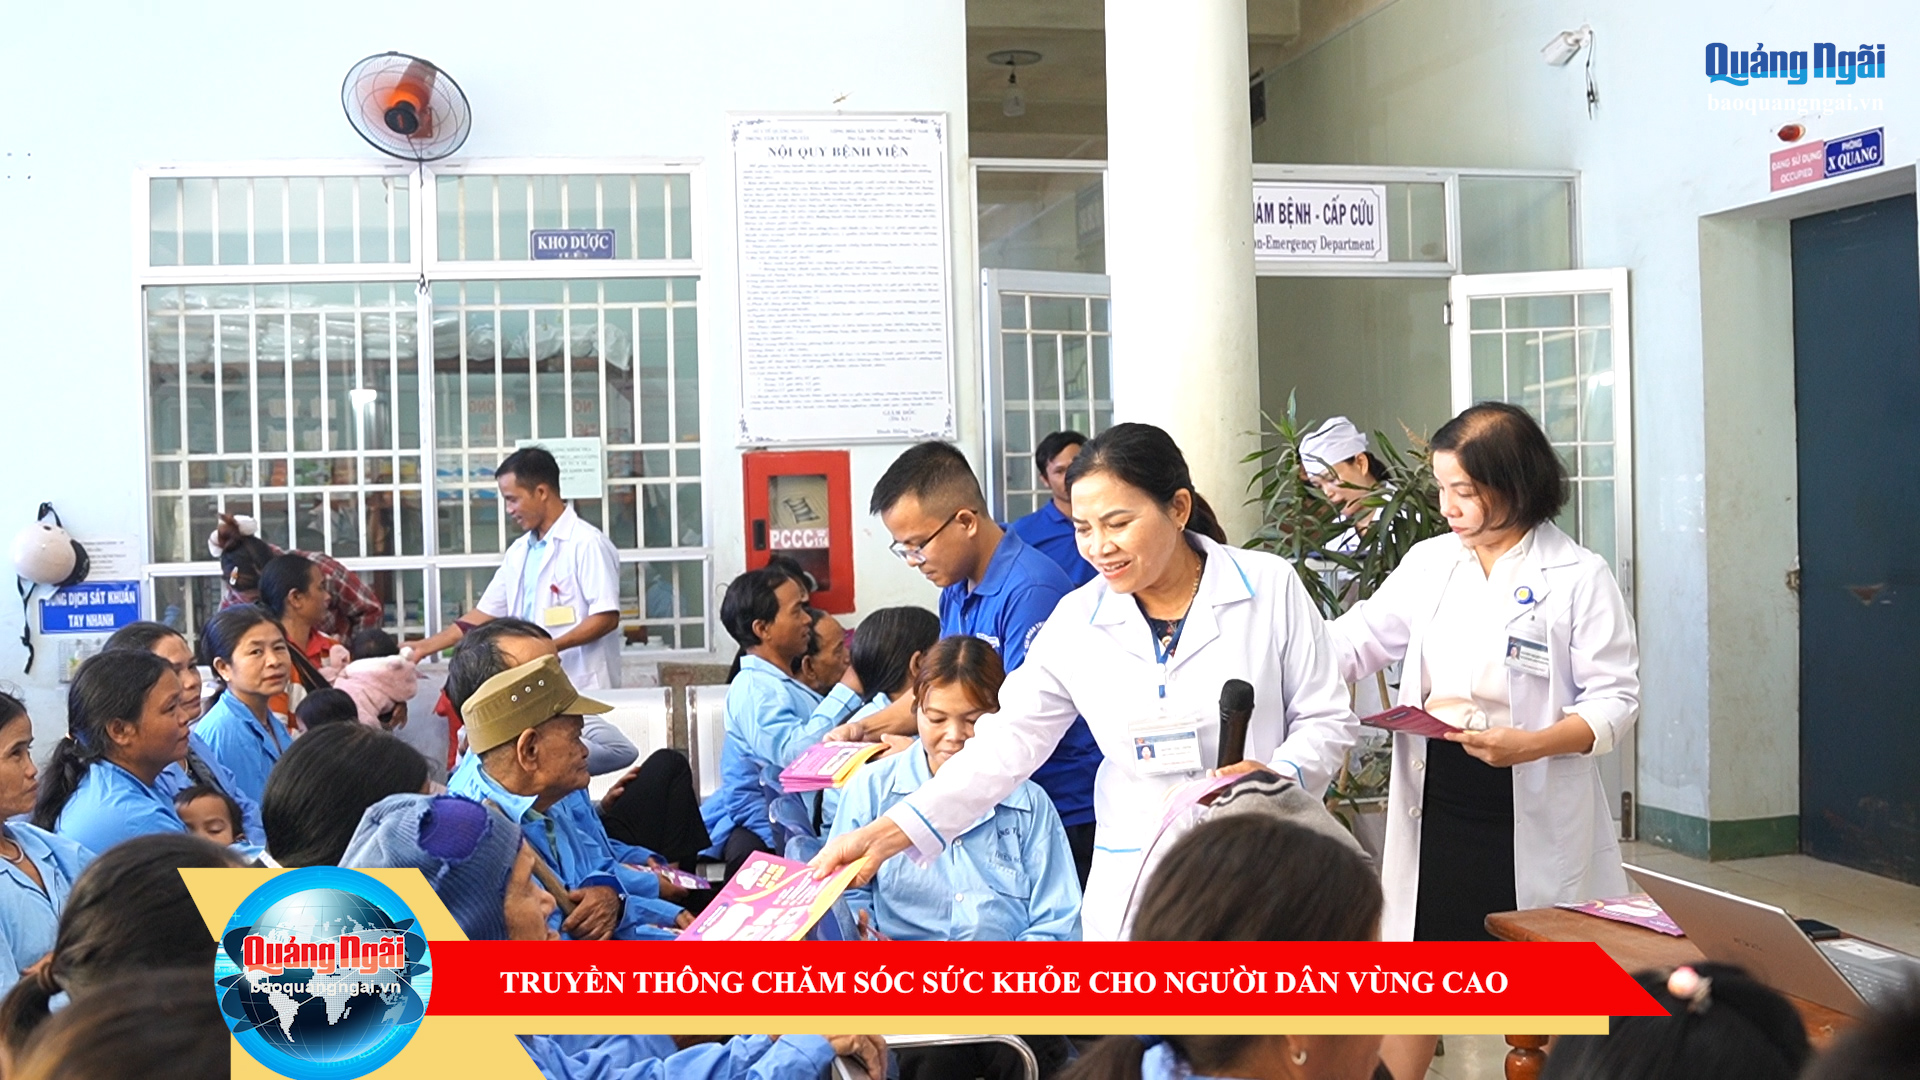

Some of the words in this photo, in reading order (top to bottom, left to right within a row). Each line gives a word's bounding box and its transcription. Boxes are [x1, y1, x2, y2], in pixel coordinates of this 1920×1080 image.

[768, 144, 792, 159] NỘI
[798, 146, 827, 160] QUY
[833, 144, 870, 159] BỆNH
[876, 144, 909, 159] VIỆN
[1828, 155, 1836, 171] X
[1837, 145, 1878, 170] QUANG
[1780, 167, 1813, 184] OCCUPIED
[1279, 196, 1311, 229] BỆNH
[1323, 194, 1346, 225] CẤP
[1350, 197, 1374, 226] CỨU
[537, 235, 568, 250] KHO
[570, 233, 609, 252] DƯỢC
[1320, 235, 1375, 254] Department
[770, 529, 814, 549] PCCC
[68, 591, 88, 609] DỊCH
[90, 588, 106, 605] SÁT
[68, 614, 84, 628] TAY
[86, 613, 114, 627] NHANH
